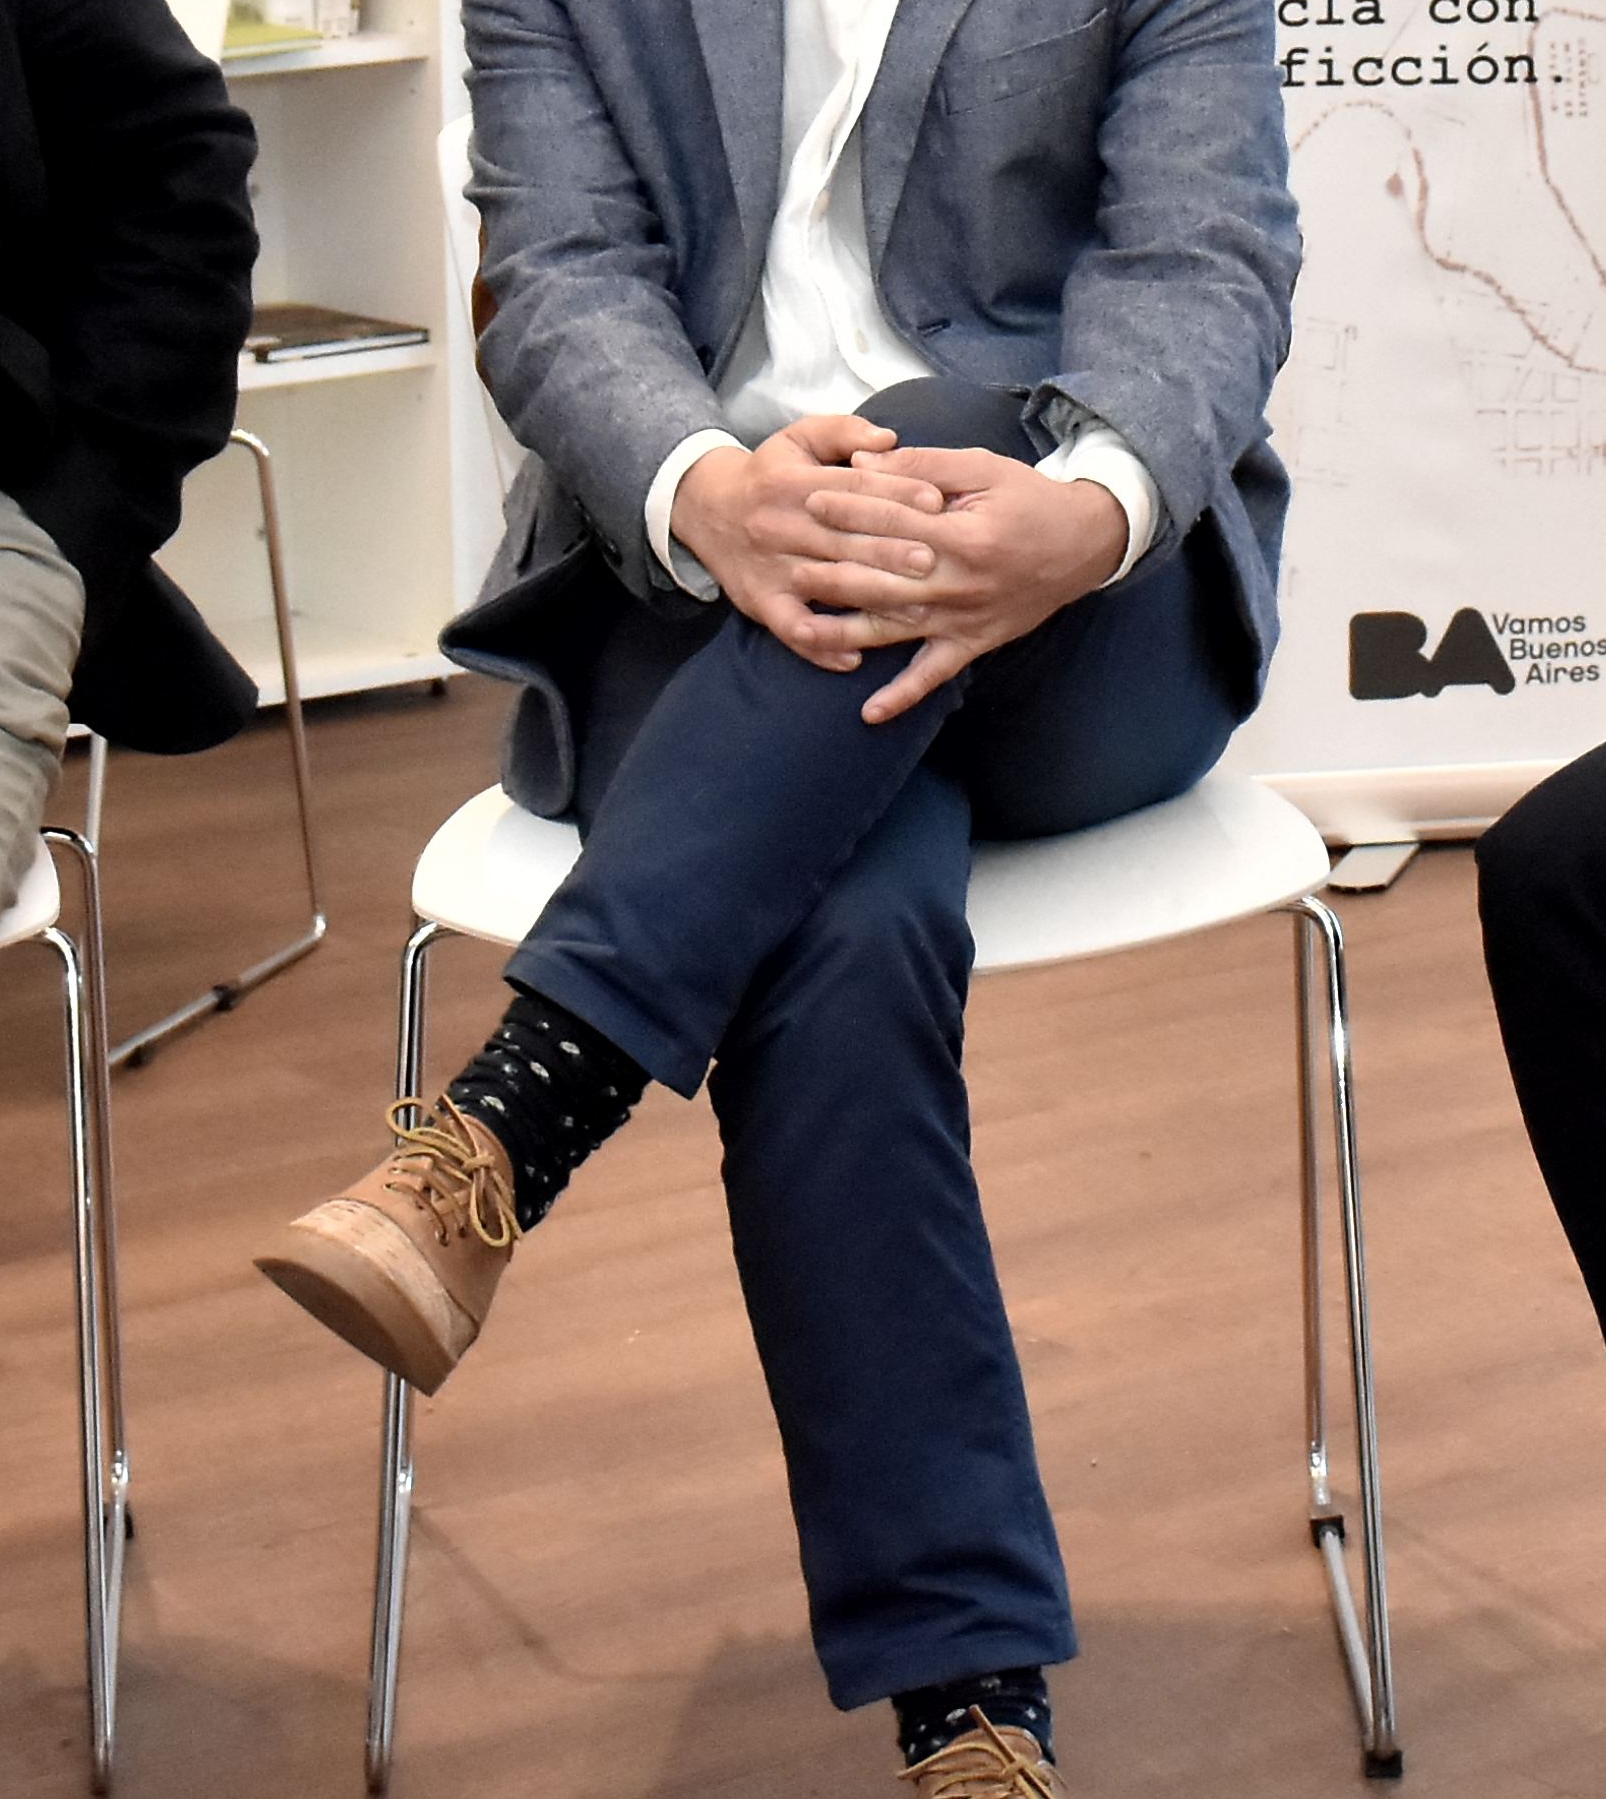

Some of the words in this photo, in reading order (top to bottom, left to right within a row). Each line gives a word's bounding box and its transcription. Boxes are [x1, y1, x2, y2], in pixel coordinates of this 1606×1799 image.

[1280, 42, 1564, 88] ficción.
[1491, 613, 1587, 636] Vamos
[1349, 607, 1517, 700] BA
[1524, 663, 1601, 685] Aires
